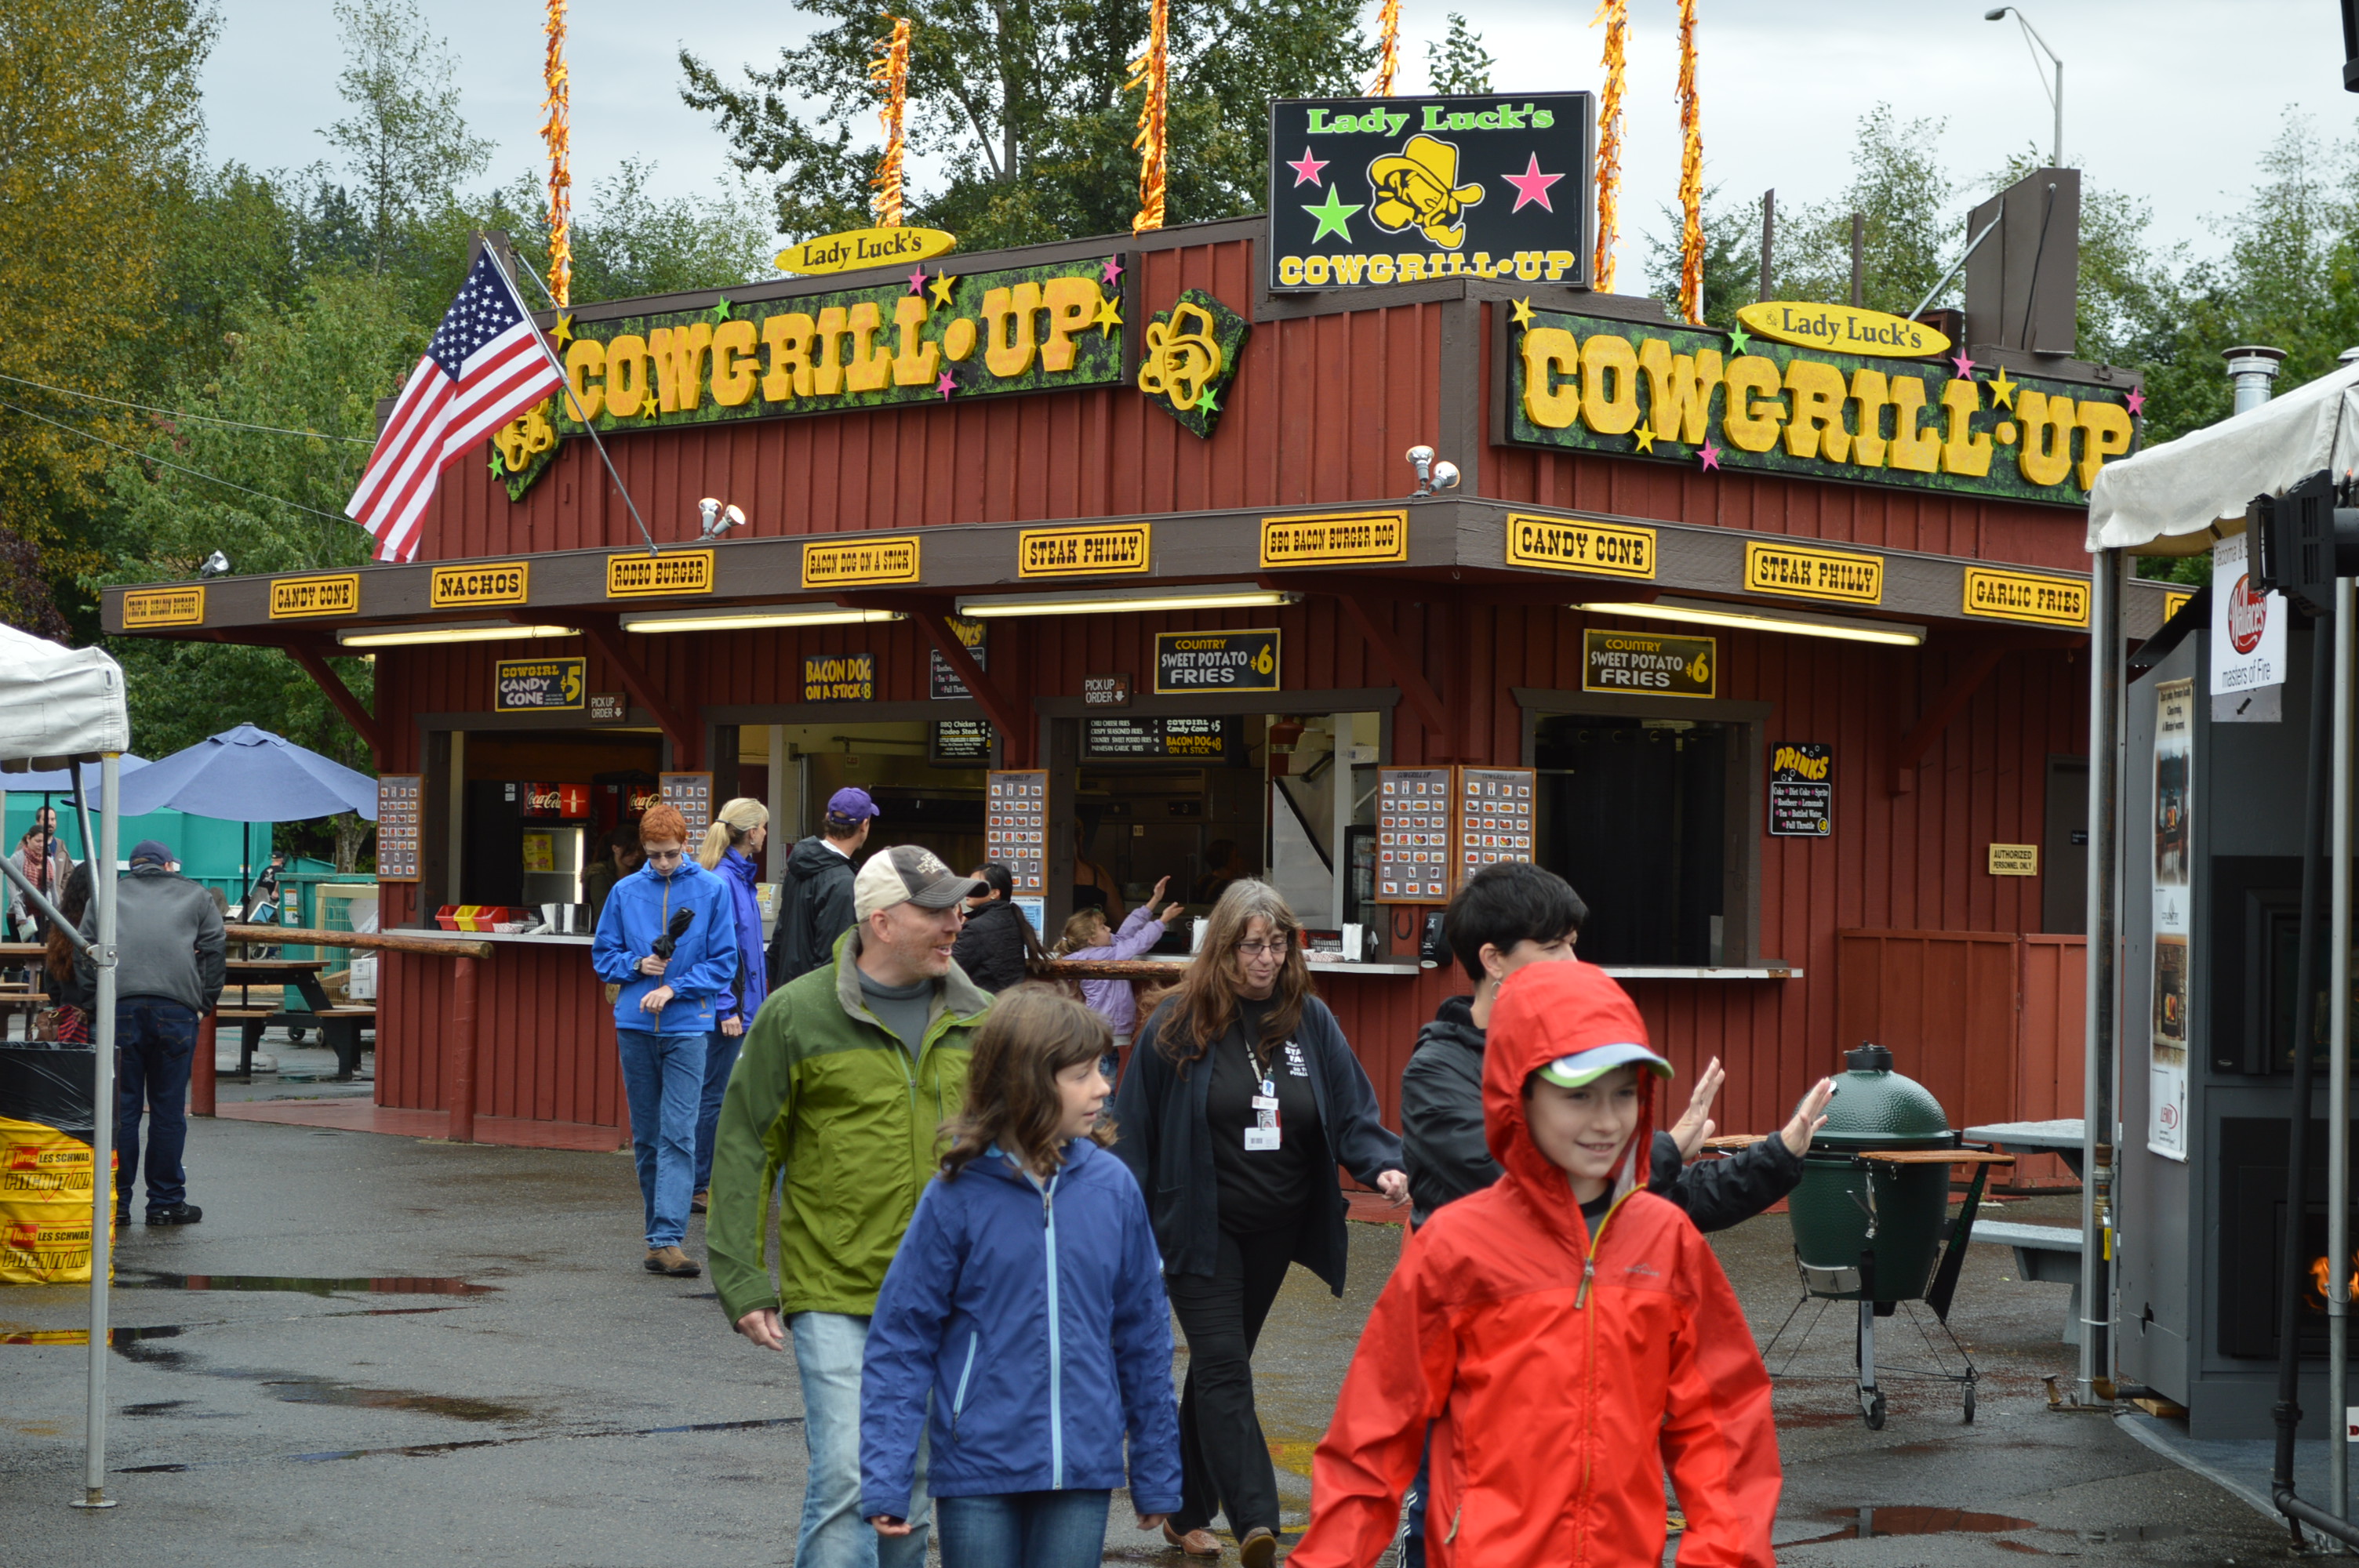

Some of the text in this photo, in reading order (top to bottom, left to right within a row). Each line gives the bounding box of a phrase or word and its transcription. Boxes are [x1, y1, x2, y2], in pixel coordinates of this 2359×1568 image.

[1307, 103, 1554, 136] Lady Luck's
[802, 230, 922, 272] Lady Luck's
[1513, 250, 1576, 281] UP
[1781, 308, 1922, 349] Lady Luck's
[564, 277, 1101, 423] COWGRILL UP
[1521, 327, 2134, 490] COWGRILL UP
[1029, 536, 1139, 566] STEAK PHILLY
[1270, 524, 1395, 554] BBQ BACON BURGER DOG
[1521, 526, 1645, 566] CANDY CONE
[614, 561, 703, 587] RODEO BURGER
[809, 549, 910, 575] BACON DOG ON A STICK
[1760, 556, 1874, 592] STEAK PHILLY
[278, 583, 350, 609] CANDY CONE
[439, 572, 519, 597] NACHOS
[1975, 581, 2080, 613] GARLIC FRIES
[1175, 639, 1227, 650] COUNTRY
[1605, 639, 1662, 652] COUNTRY
[805, 658, 871, 684] BACON DOG
[1161, 643, 1274, 675] SWEET POTATO $6
[1590, 651, 1709, 683] SWEET POTATO $6
[500, 677, 551, 693] CANDY
[502, 665, 560, 678] COWGIRL
[560, 666, 581, 702] $5
[1085, 678, 1115, 691] PICK UP
[1170, 667, 1235, 684] FRIES
[1601, 669, 1670, 688] FRIES
[2222, 657, 2271, 689] masters of Fire
[506, 691, 543, 706] CONE
[591, 696, 615, 708] PICK UP
[805, 682, 871, 700] ON A STICK $8
[1085, 691, 1113, 703] ORDER
[591, 708, 613, 718] ORDER
[1166, 725, 1189, 734] Candy
[1166, 735, 1194, 746] BACON
[1194, 735, 1212, 746] DOG
[1190, 746, 1210, 754] STICK
[1773, 746, 1829, 781] DRINKS
[1994, 849, 2033, 860] AUTHORIZED
[1994, 861, 2019, 869] PERSONNEL
[14, 1150, 90, 1164] Tires LES SCHWAB
[4, 1173, 52, 1191] PITCH
[51, 1173, 70, 1191] IT
[13, 1226, 89, 1242] Tires LES SCHWAB
[2, 1250, 49, 1269] PITCH
[48, 1251, 67, 1269] IT
